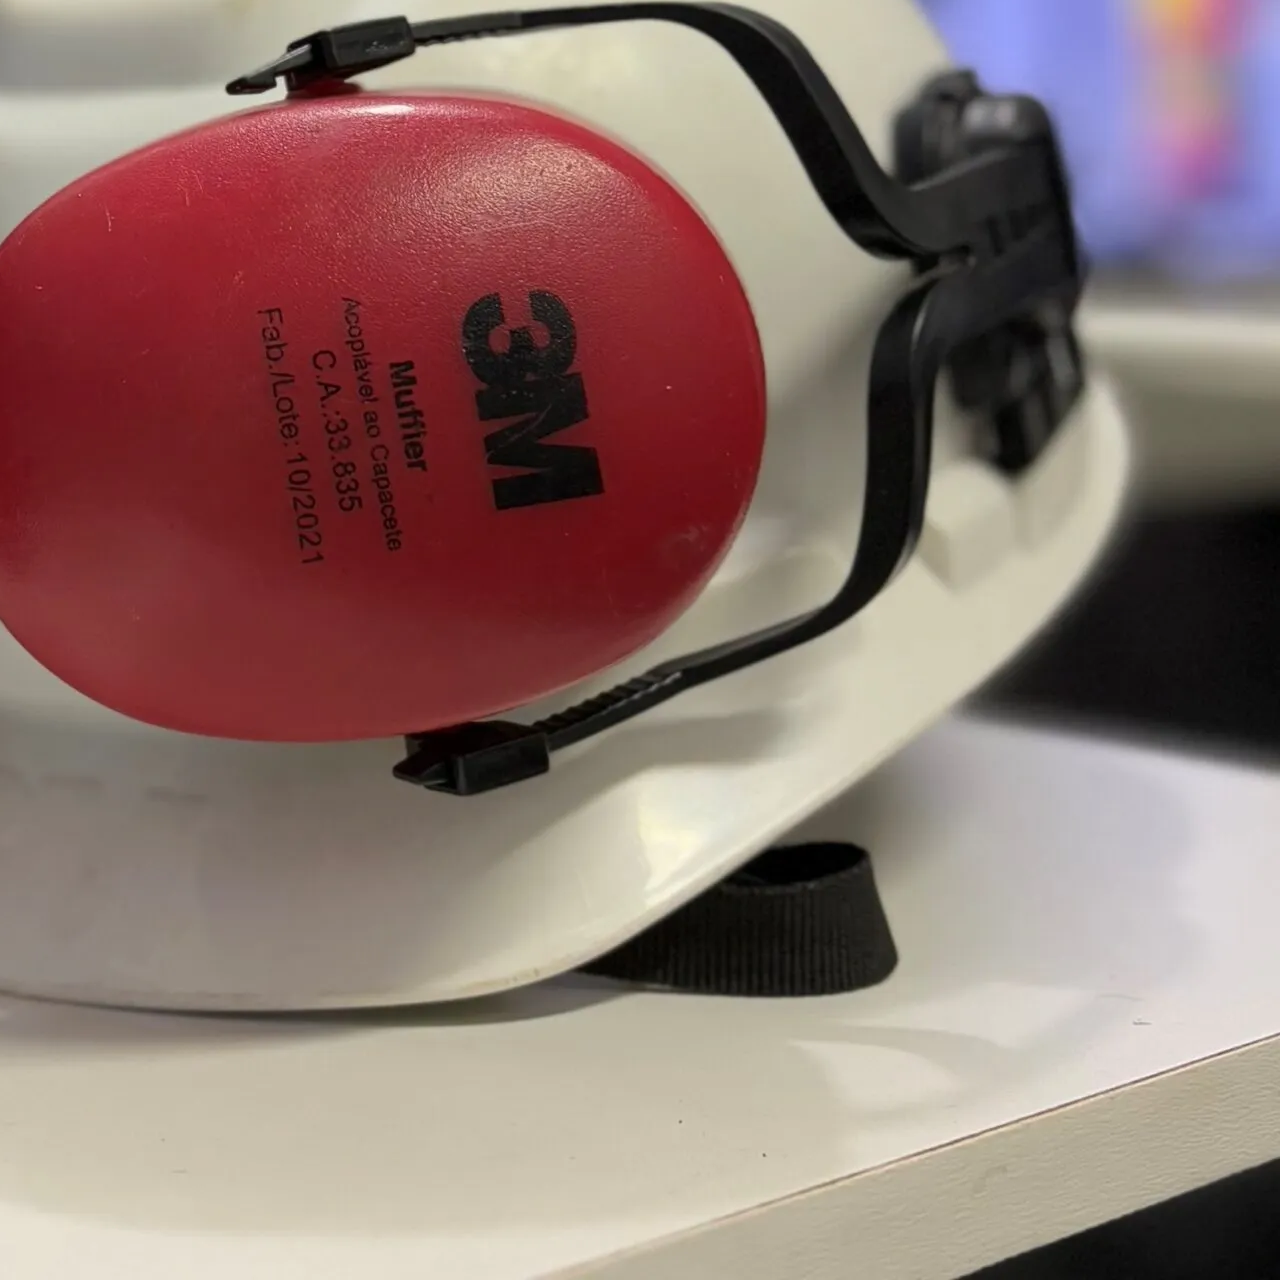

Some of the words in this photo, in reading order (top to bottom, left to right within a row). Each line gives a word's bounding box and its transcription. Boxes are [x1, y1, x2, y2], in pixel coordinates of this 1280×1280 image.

[362, 409, 381, 438] ao
[461, 289, 605, 510] 3M
[370, 443, 403, 552] Capacete
